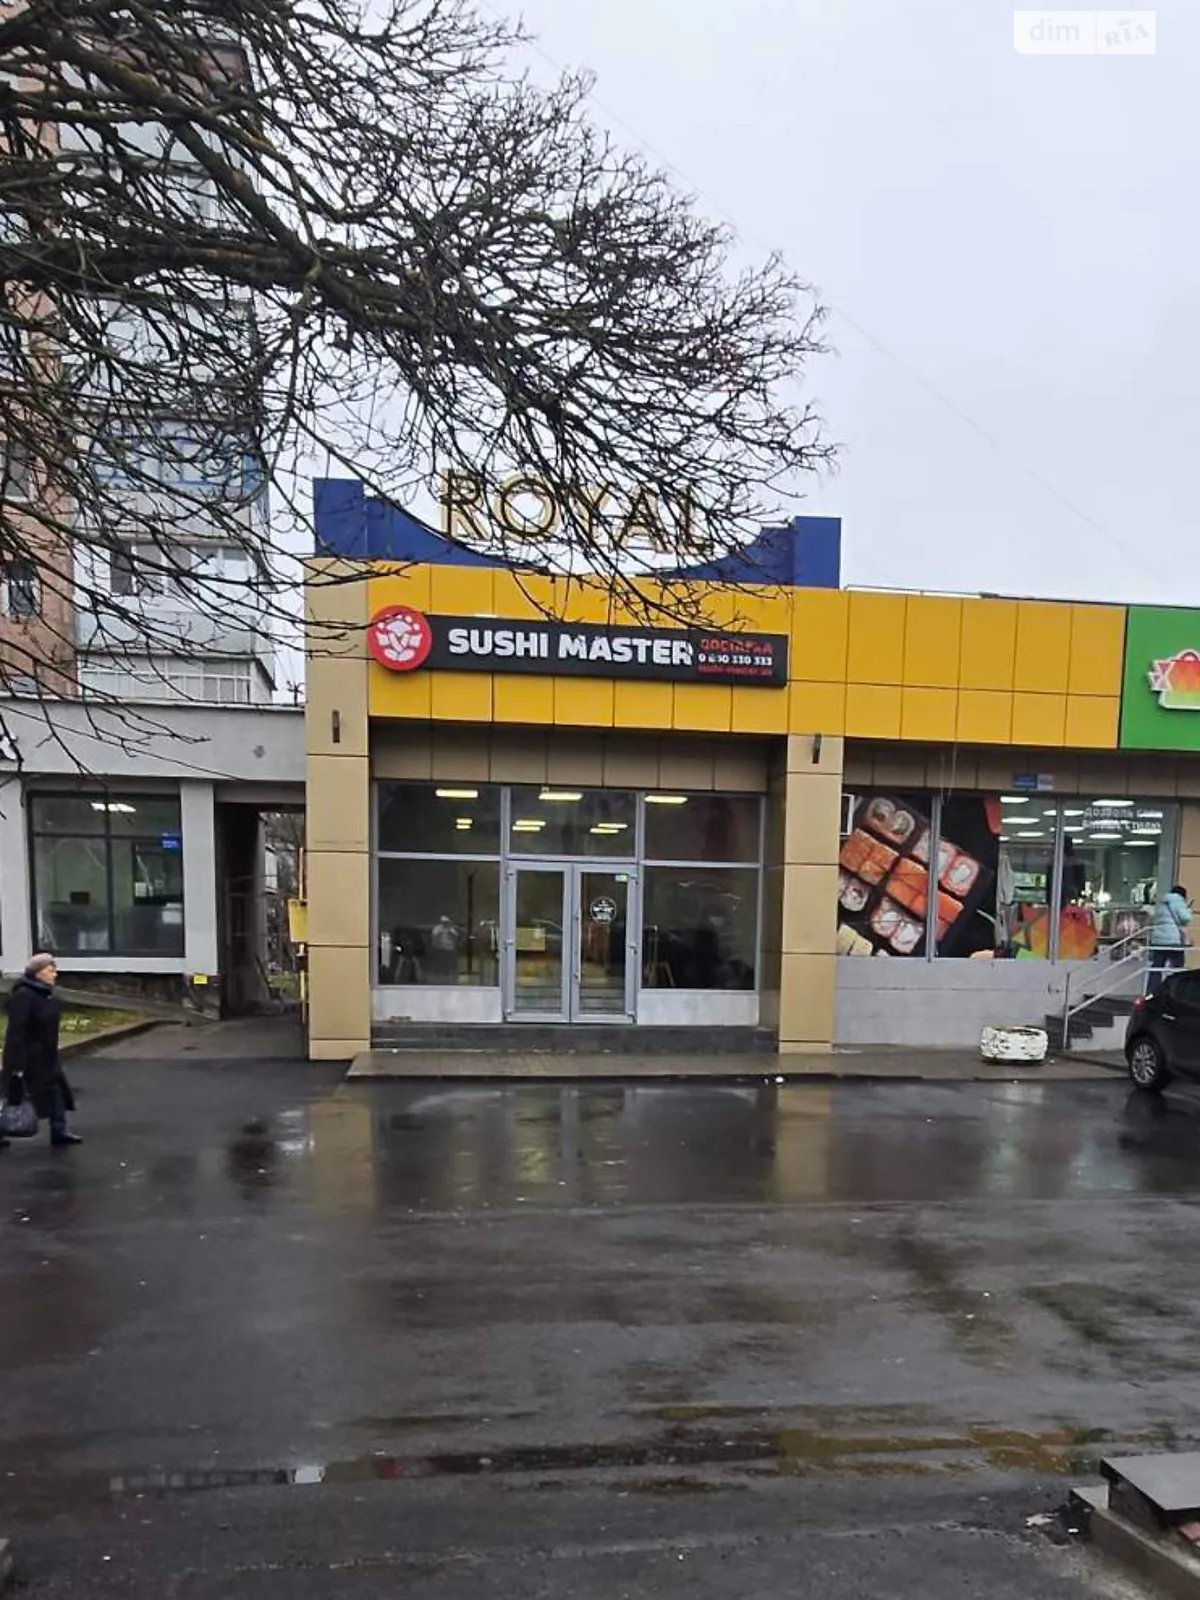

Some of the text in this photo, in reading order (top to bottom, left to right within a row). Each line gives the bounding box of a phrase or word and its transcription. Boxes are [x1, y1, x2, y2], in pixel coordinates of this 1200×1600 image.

[440, 468, 715, 555] ROYAL
[448, 628, 694, 666] SUSHI MASTER
